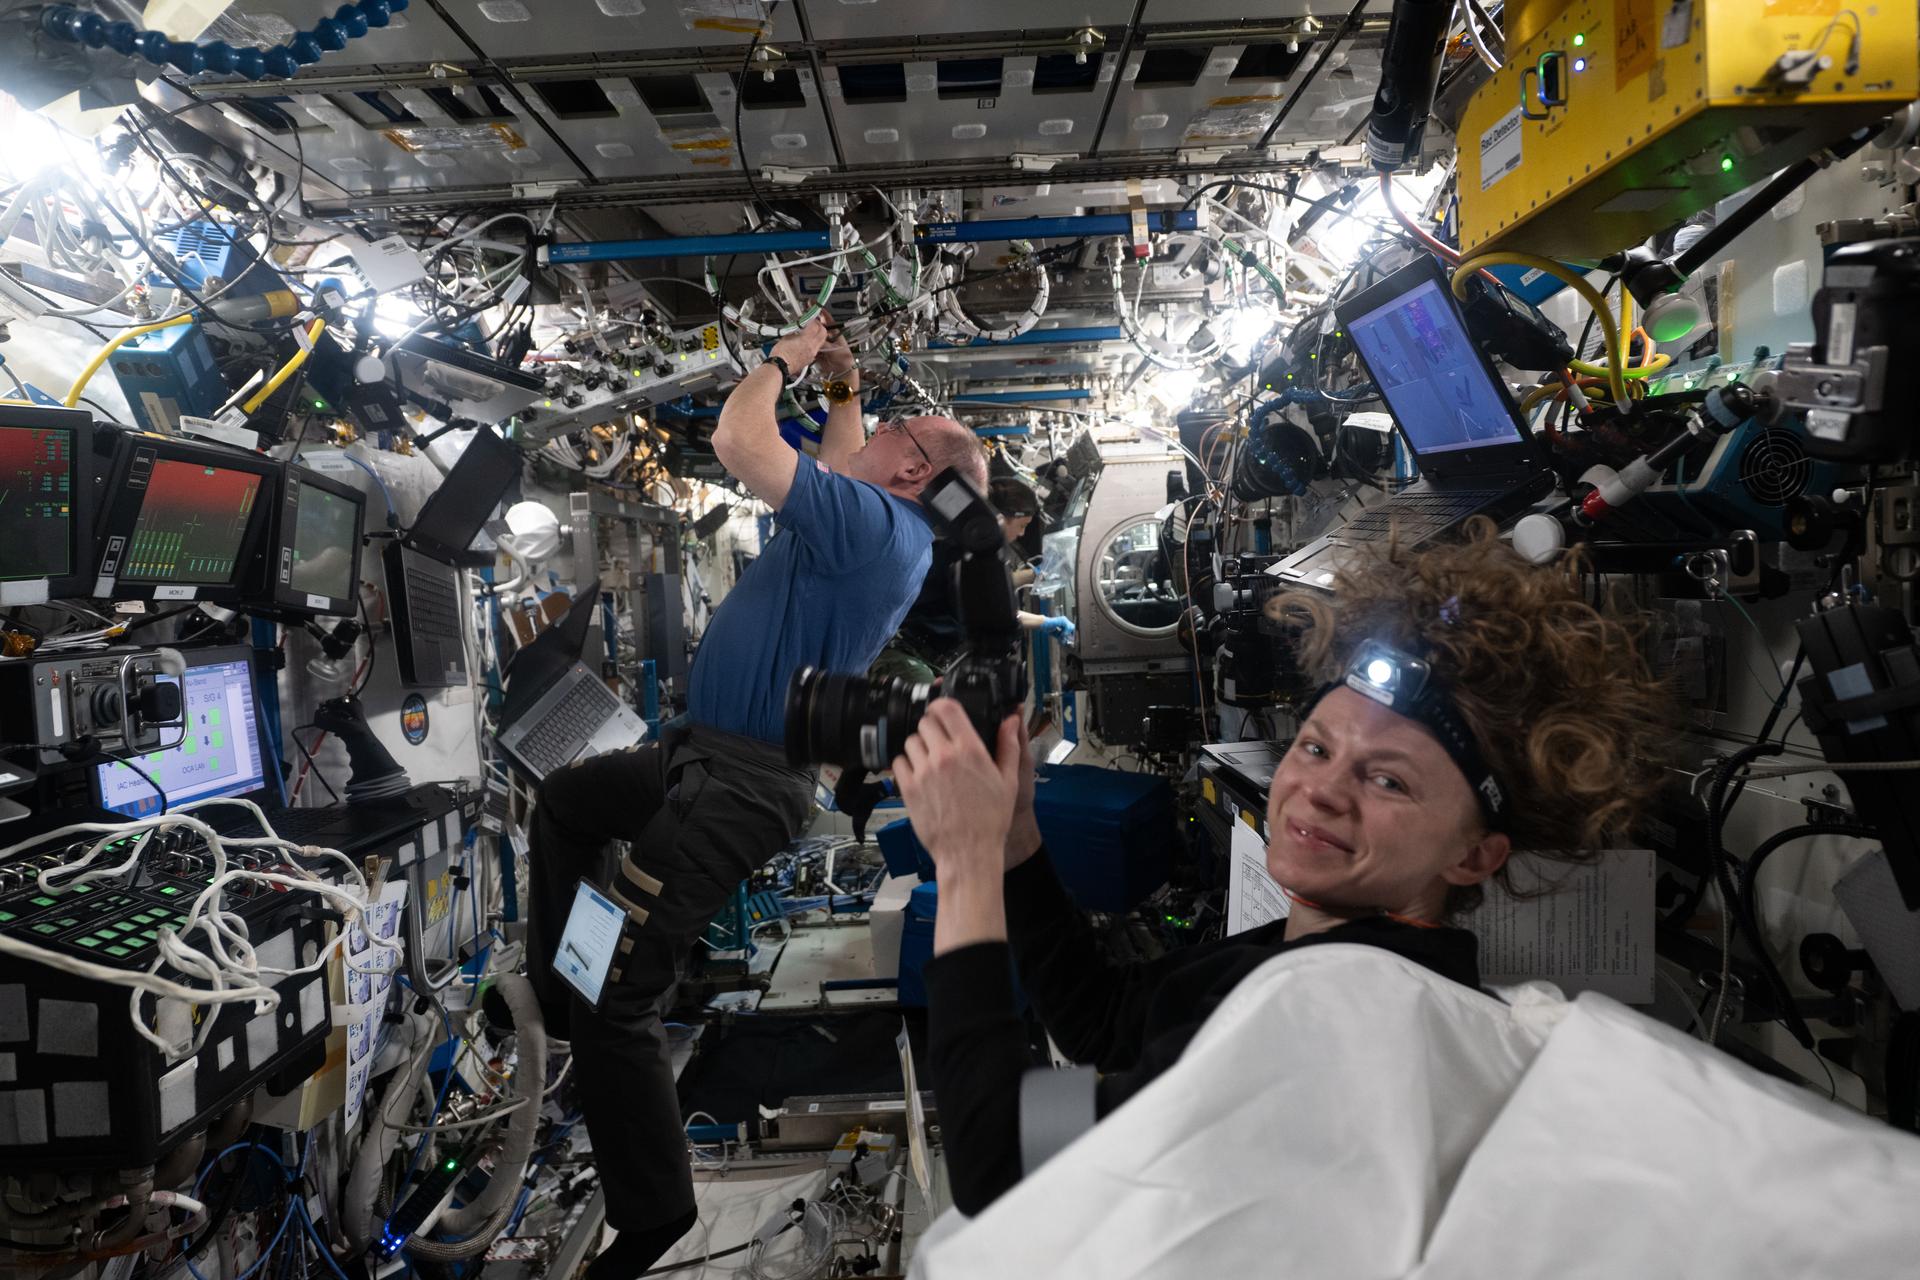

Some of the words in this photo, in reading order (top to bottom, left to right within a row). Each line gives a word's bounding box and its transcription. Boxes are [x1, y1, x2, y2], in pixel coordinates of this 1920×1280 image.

[1481, 133, 1493, 152] Rad
[1493, 114, 1519, 142] Detector
[182, 765, 194, 774] OCA
